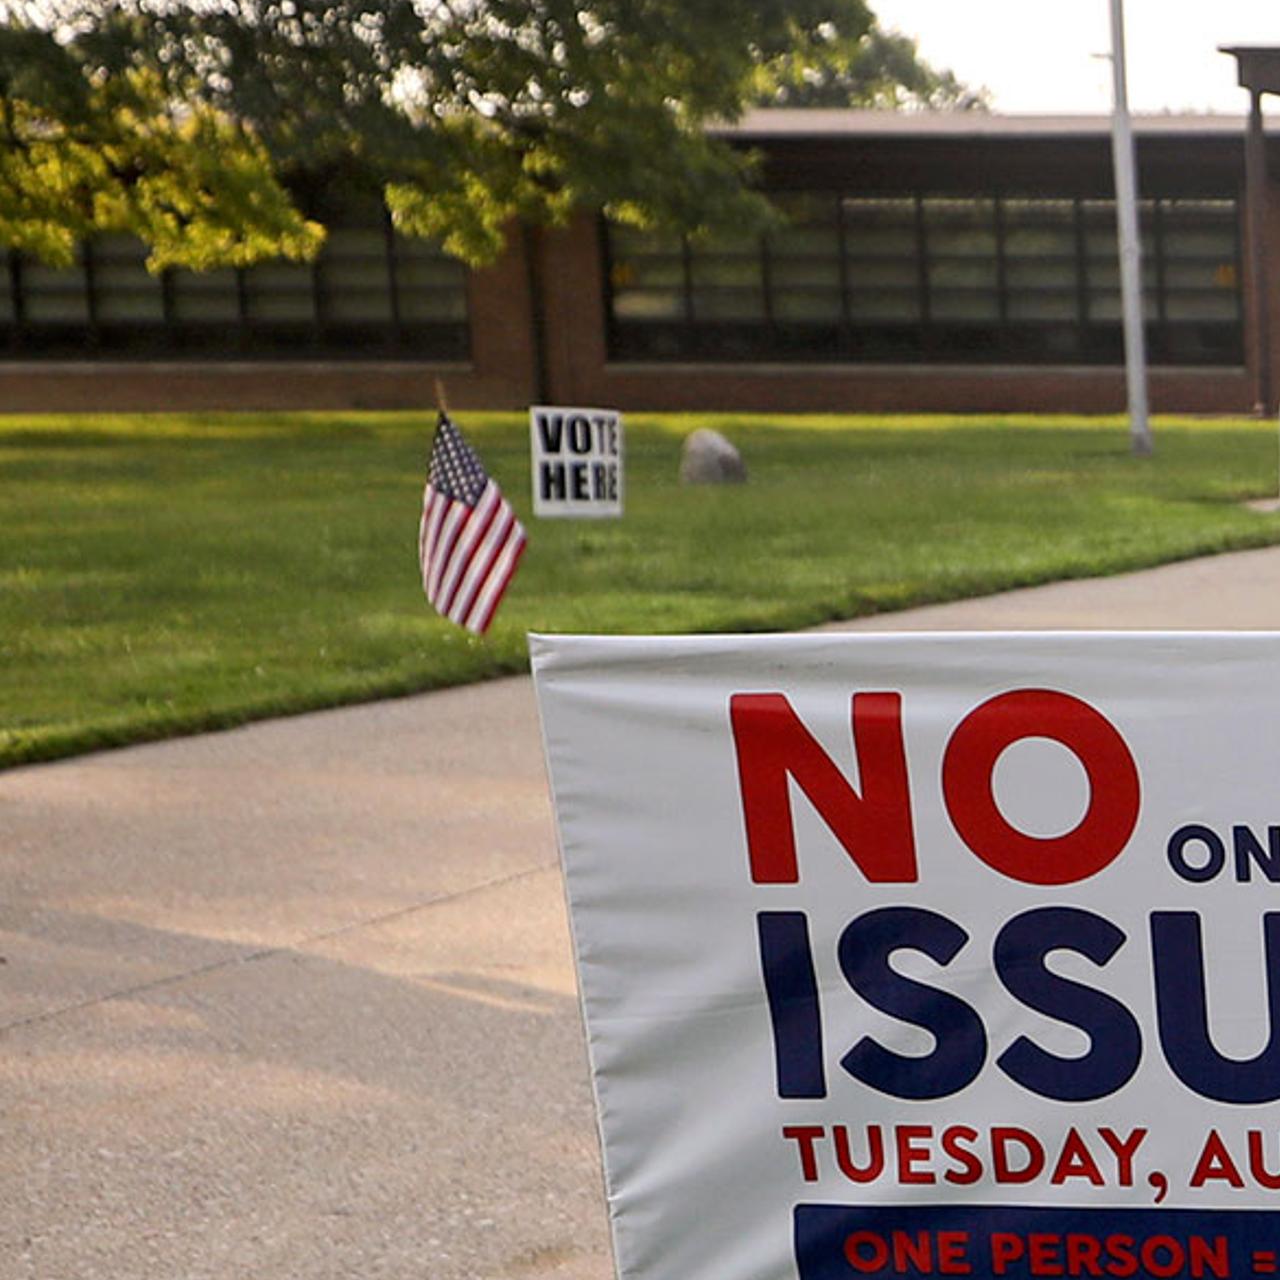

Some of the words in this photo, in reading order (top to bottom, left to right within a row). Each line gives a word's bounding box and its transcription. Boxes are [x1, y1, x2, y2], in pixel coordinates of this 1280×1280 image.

[535, 414, 618, 455] VOTE
[540, 462, 618, 501] HERE
[729, 688, 1141, 887] NO
[782, 1124, 1168, 1205] TUESDAY,
[846, 1231, 971, 1273] ONE
[990, 1233, 1229, 1278] PERSON
